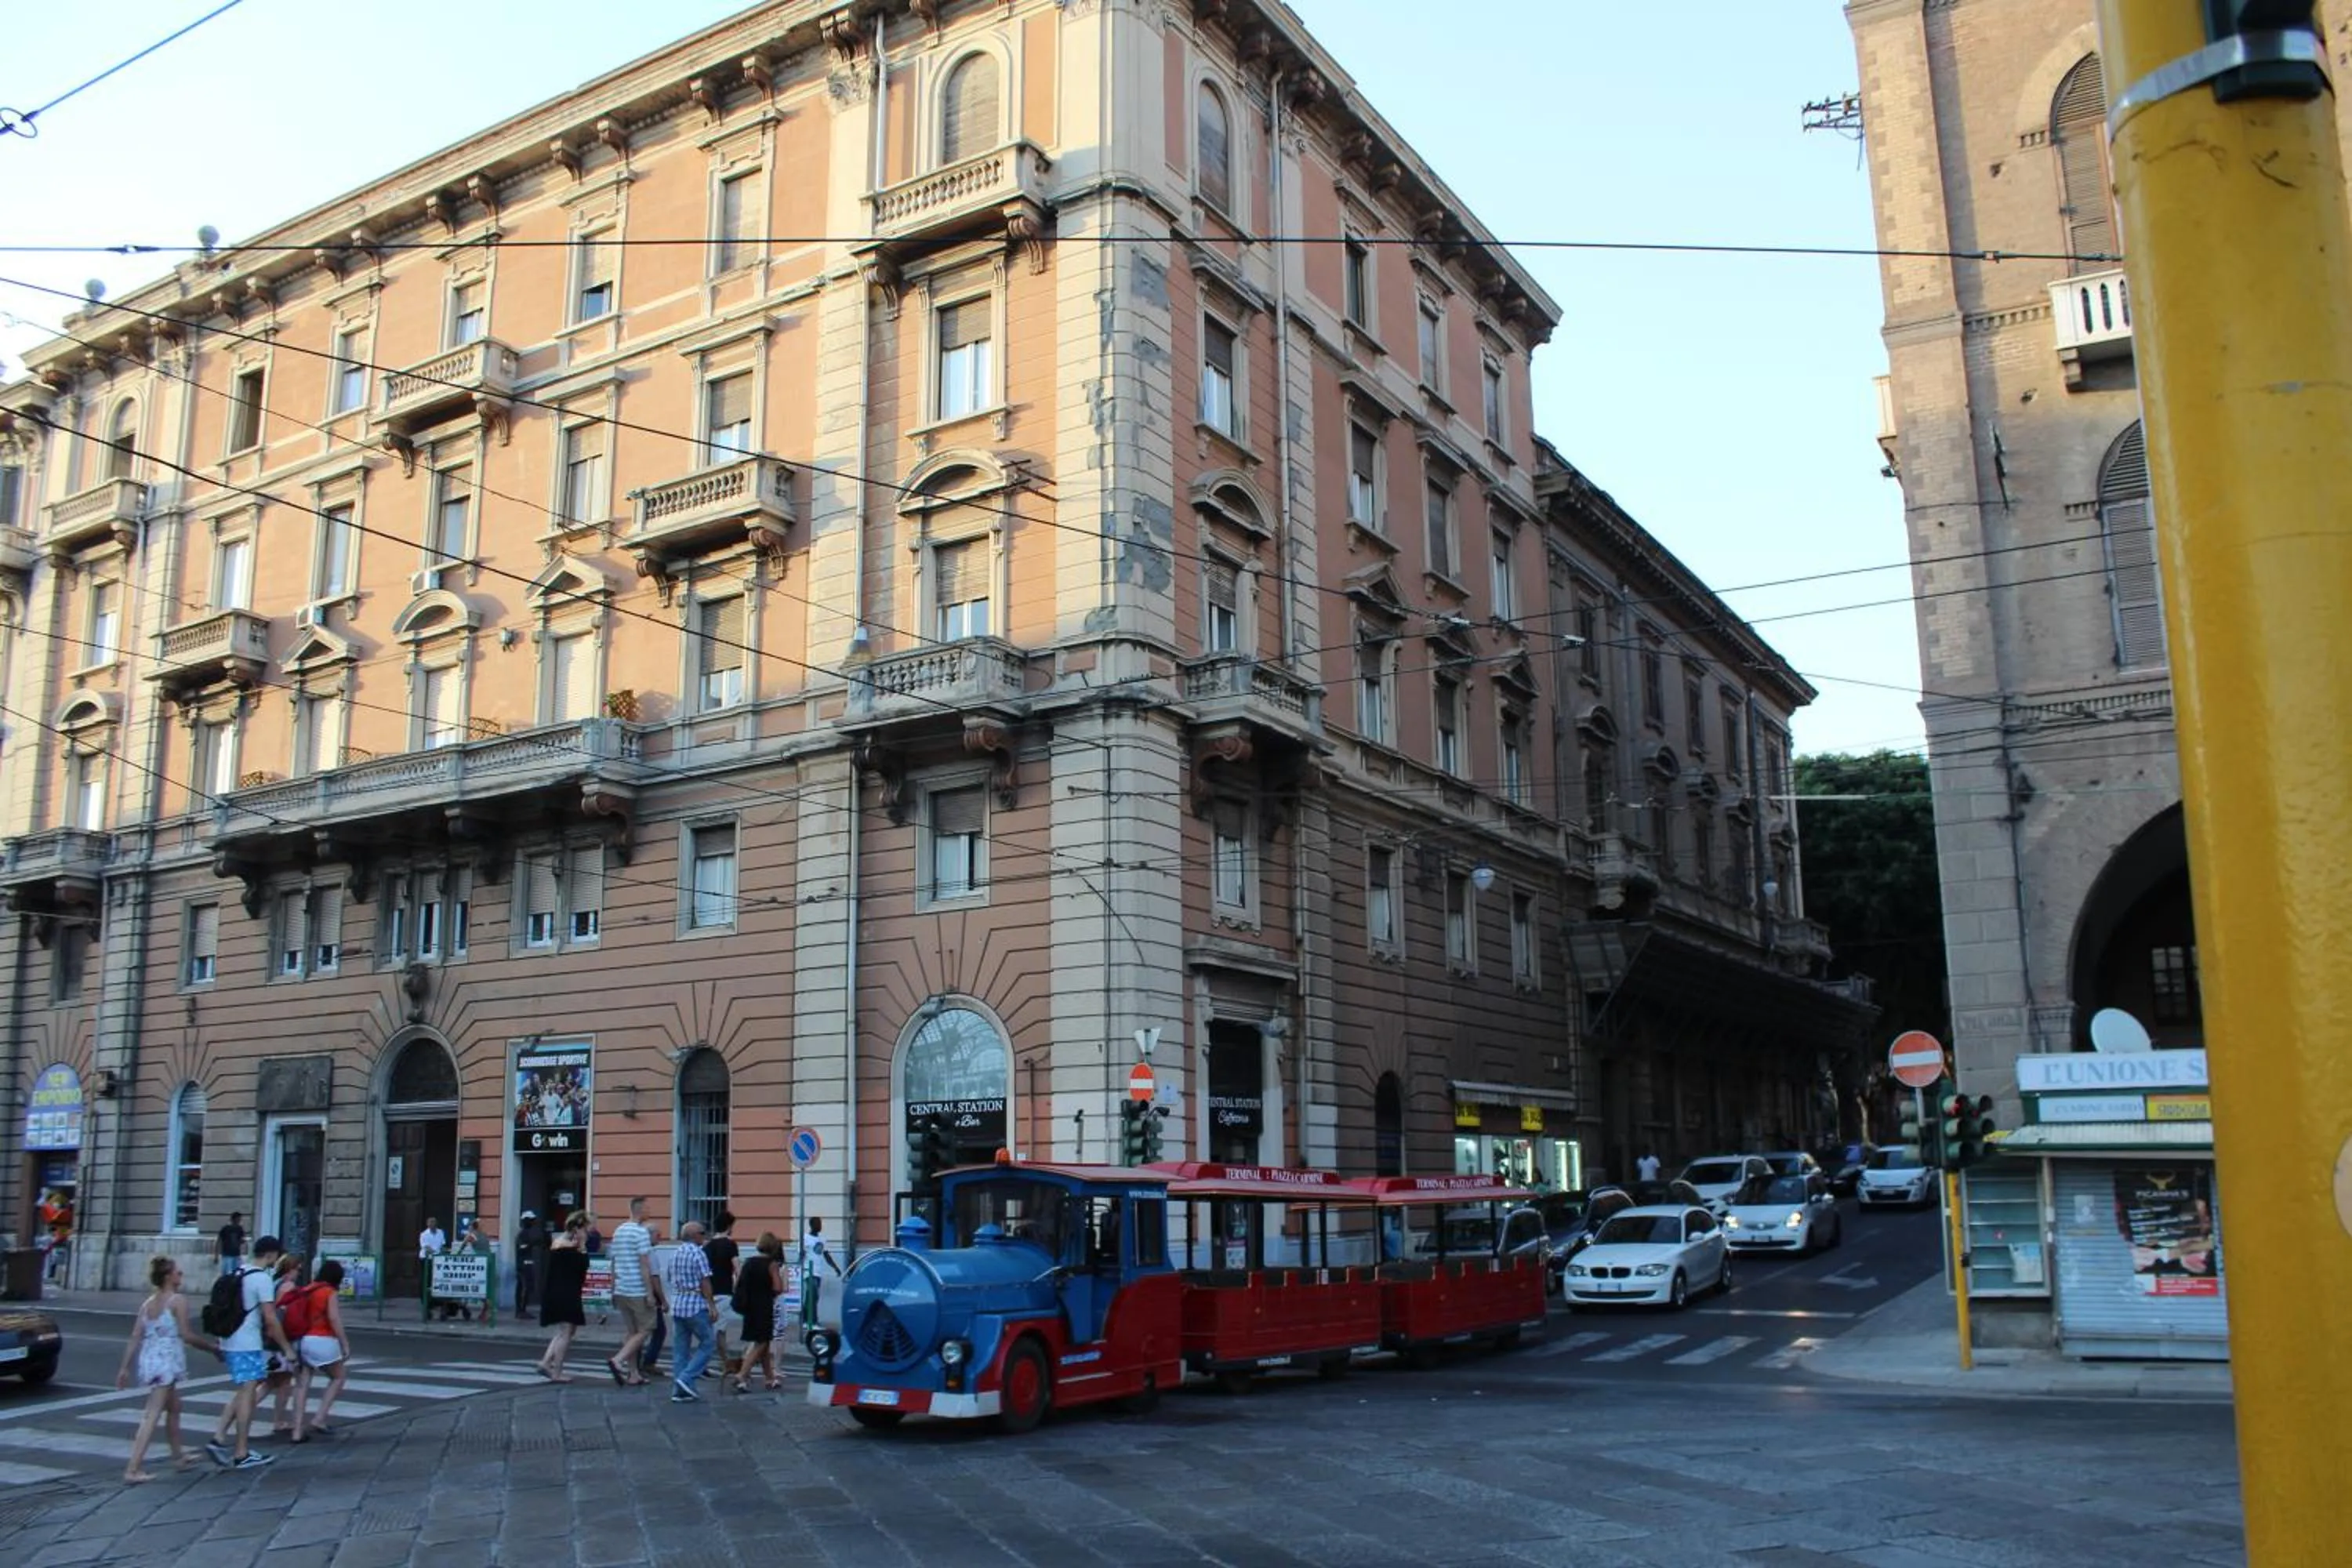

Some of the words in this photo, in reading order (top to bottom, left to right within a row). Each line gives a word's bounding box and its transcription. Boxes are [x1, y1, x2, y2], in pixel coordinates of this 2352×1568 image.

[2043, 1059, 2177, 1084] L'UNIONE
[909, 1103, 956, 1115] CENTRAL
[957, 1100, 1004, 1112] STATION
